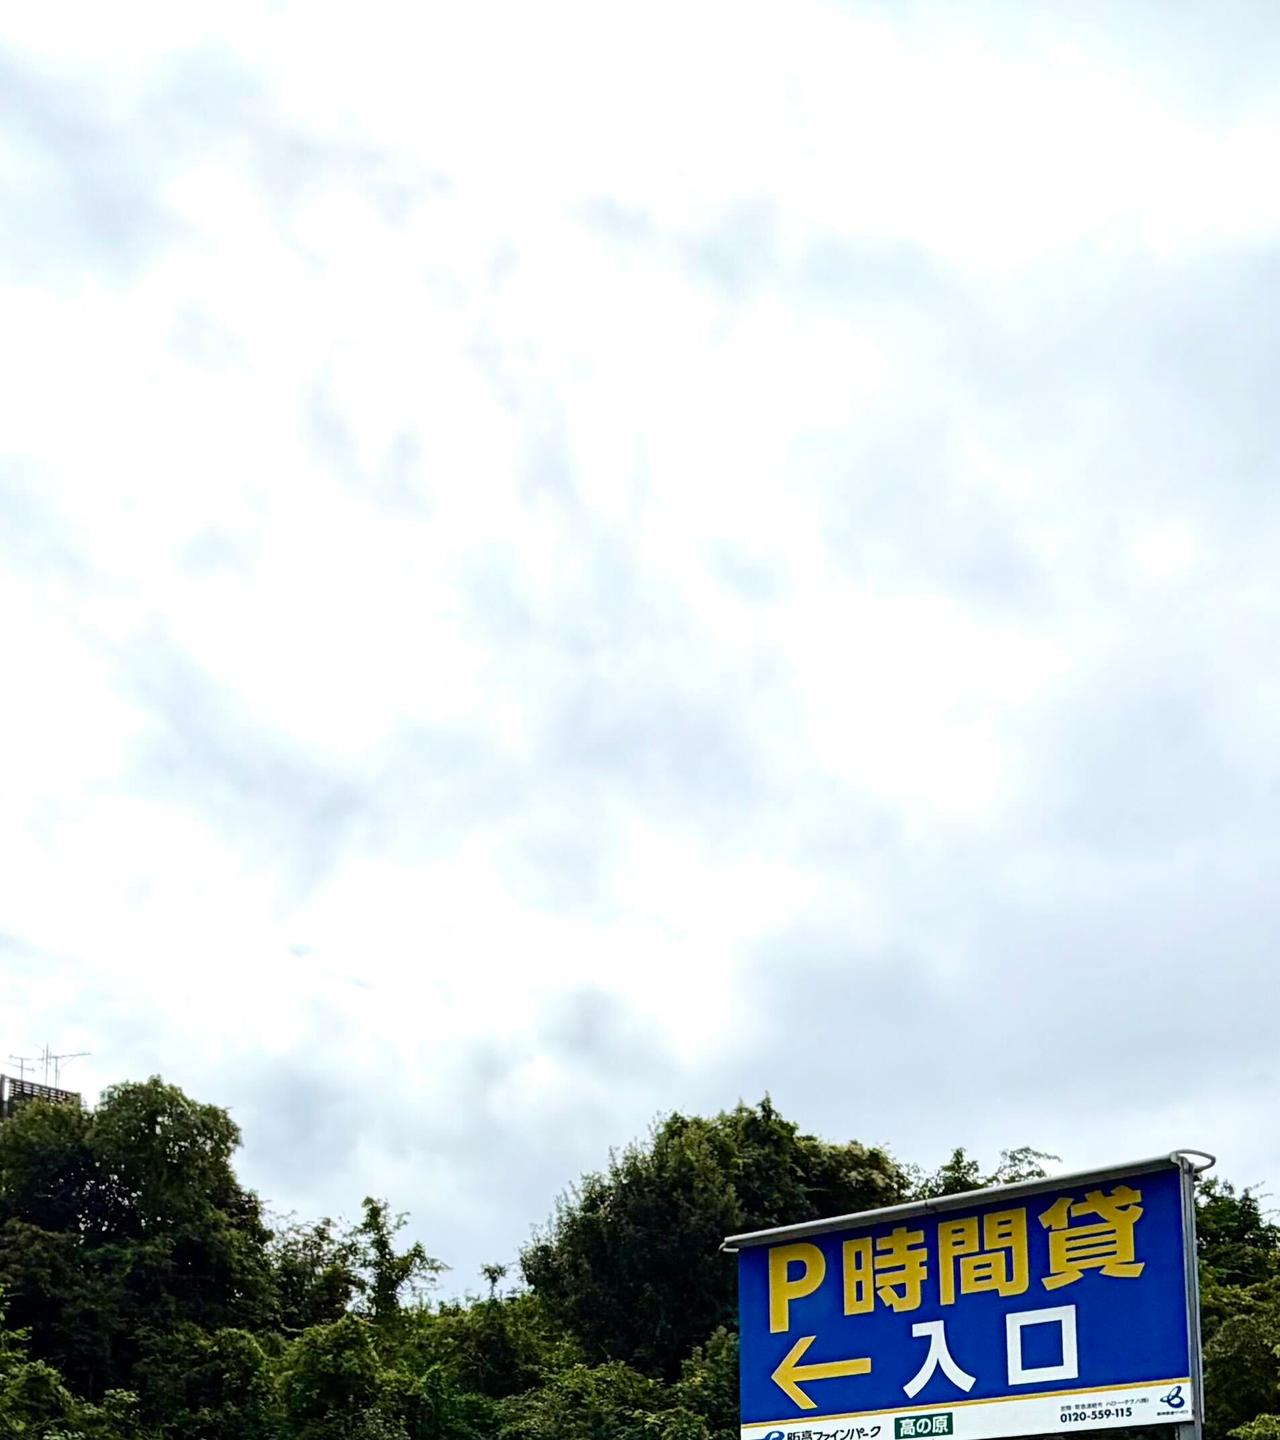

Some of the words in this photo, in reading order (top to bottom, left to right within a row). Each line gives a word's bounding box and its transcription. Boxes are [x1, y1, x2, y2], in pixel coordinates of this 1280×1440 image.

[902, 1303, 1079, 1400] 入口
[899, 1415, 949, 1437] 高の原
[1060, 1407, 1133, 1423] 0120-559-115
